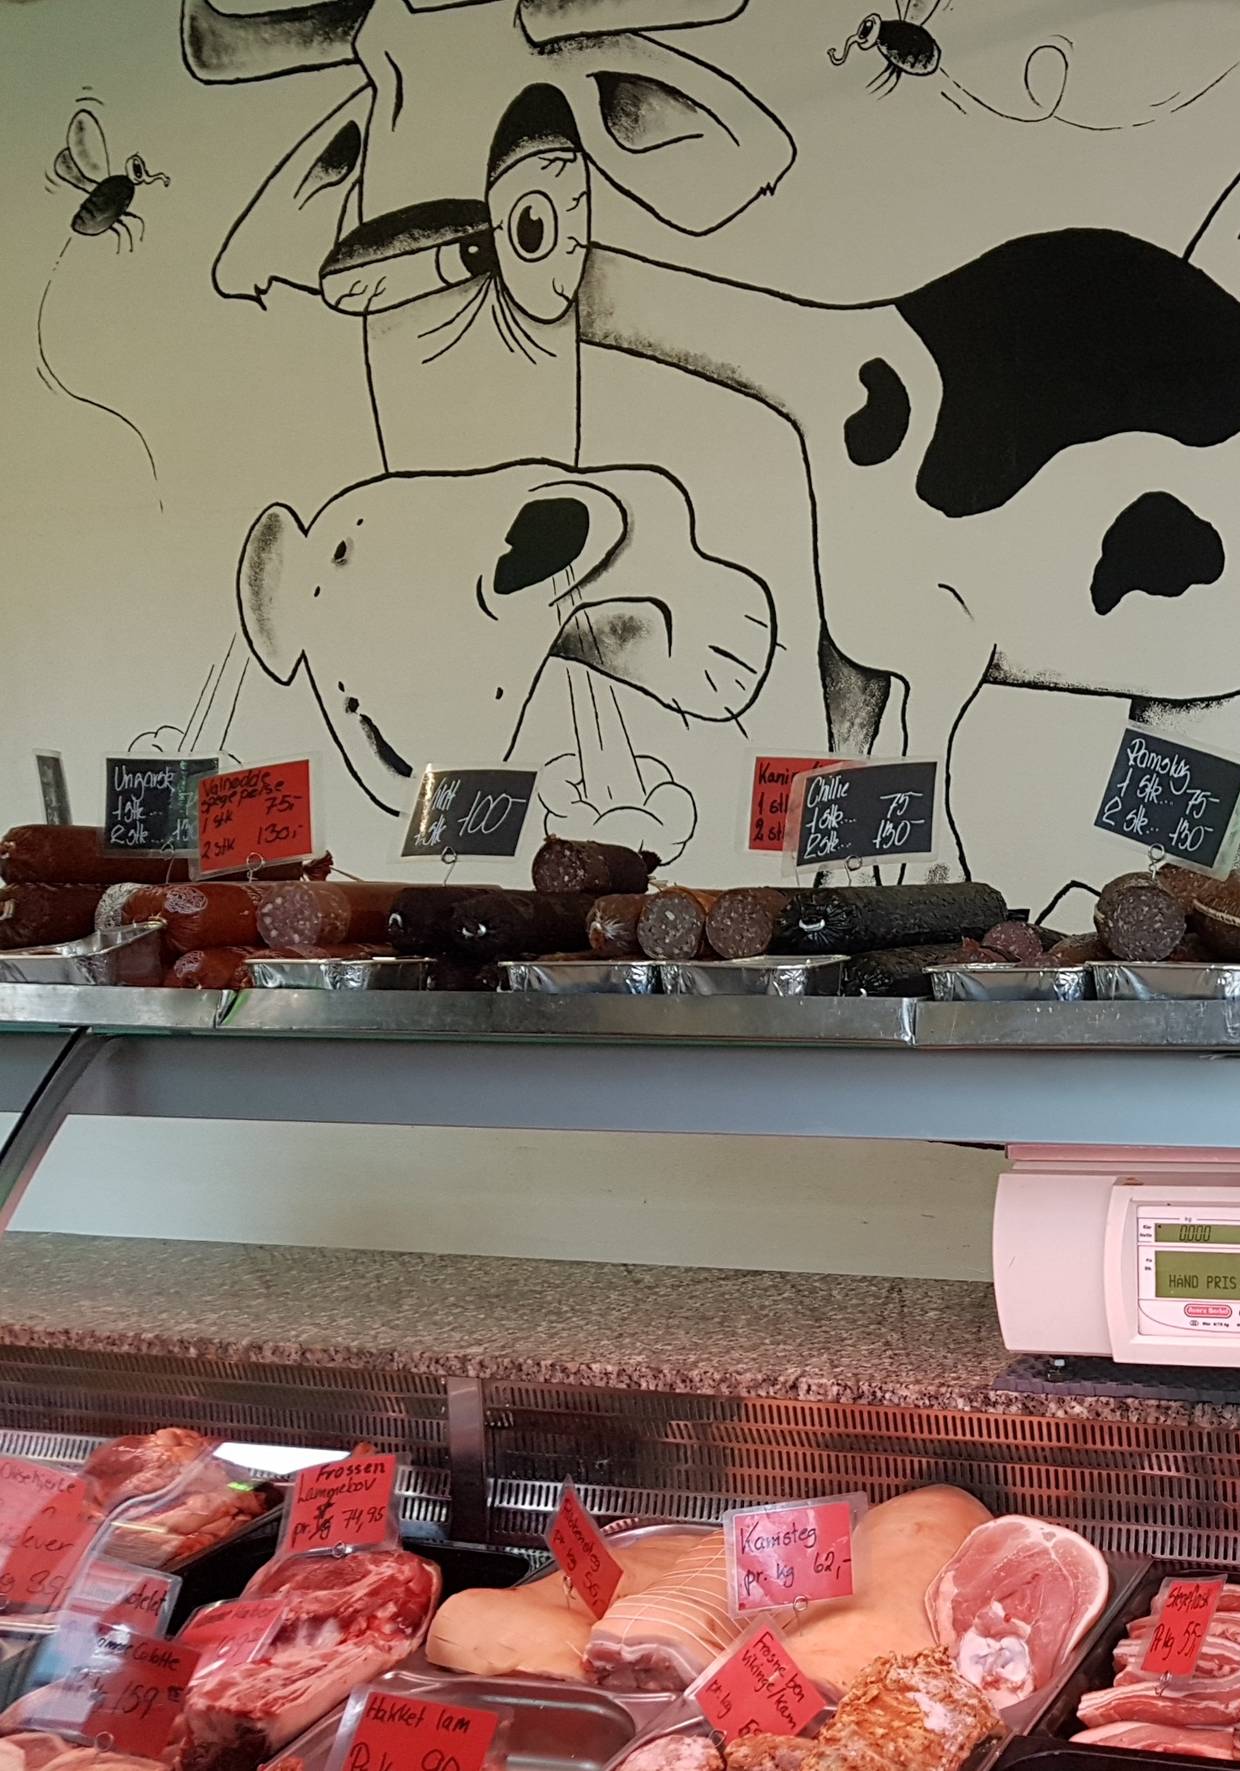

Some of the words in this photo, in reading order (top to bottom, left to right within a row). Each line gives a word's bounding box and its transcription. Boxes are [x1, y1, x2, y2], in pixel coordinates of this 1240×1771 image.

[1117, 768, 1133, 797] 1
[1102, 797, 1121, 826] 2
[754, 819, 764, 840] 2
[1207, 1276, 1237, 1289] PRIS
[316, 1462, 385, 1482] Frossen
[776, 1563, 794, 1588] kg
[814, 1551, 851, 1579] 62,-
[366, 1696, 425, 1729] Hakket
[436, 1709, 471, 1734] lam
